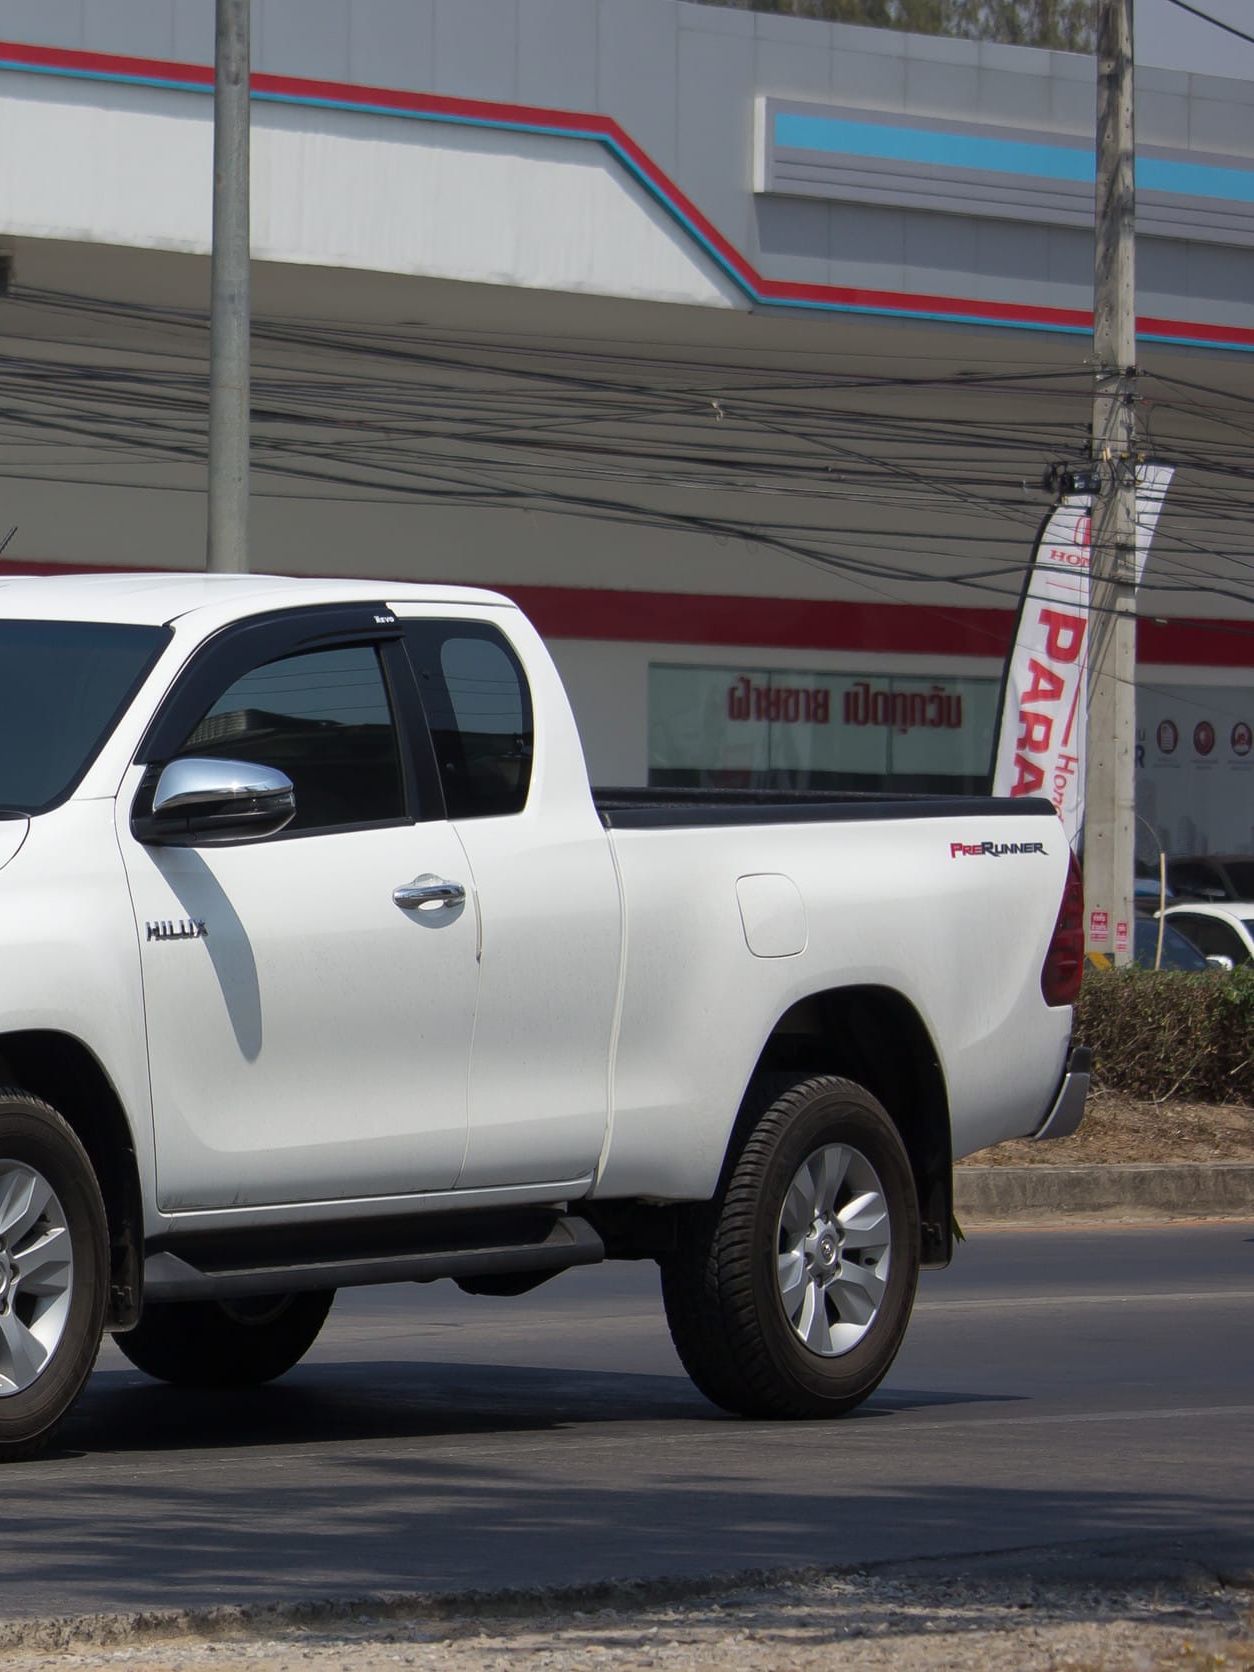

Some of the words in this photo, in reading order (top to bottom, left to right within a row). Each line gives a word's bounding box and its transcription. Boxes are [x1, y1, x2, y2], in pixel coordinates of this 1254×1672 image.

[728, 676, 830, 724] ฝ่ายขาย
[843, 681, 962, 735] เปิดทุกวัน
[145, 918, 208, 942] HILUX
